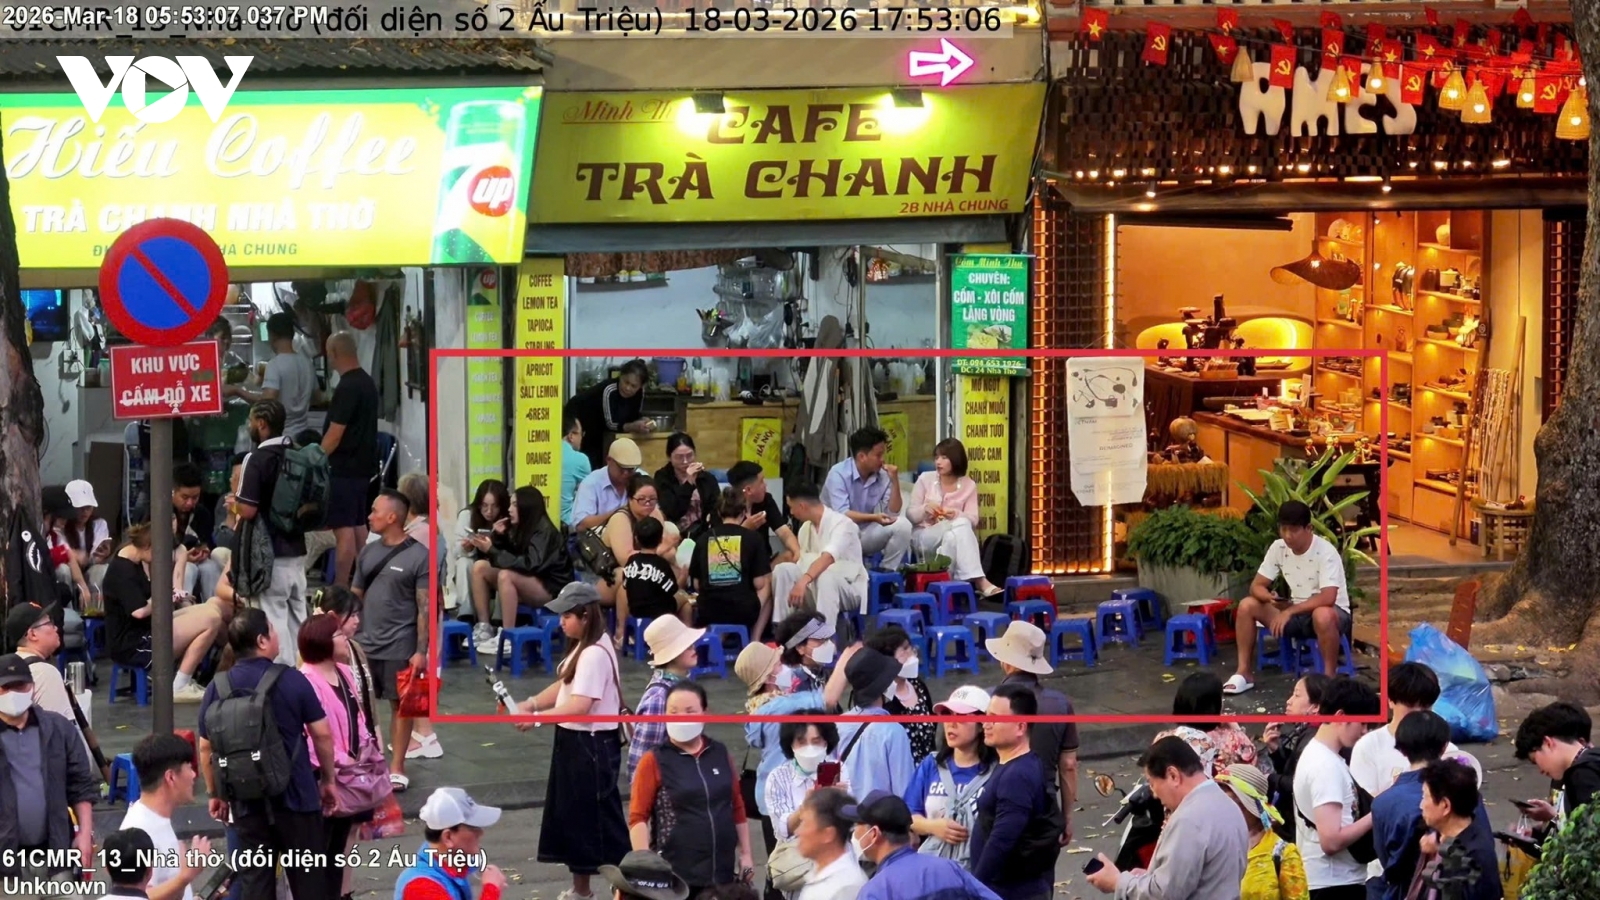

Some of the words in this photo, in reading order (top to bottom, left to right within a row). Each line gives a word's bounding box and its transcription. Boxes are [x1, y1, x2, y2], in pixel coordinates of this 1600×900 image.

[563, 100, 633, 120] Minh
[707, 103, 884, 145] CAFE
[205, 112, 418, 189] Coffee
[576, 152, 715, 204] TRÀ
[744, 154, 998, 200] CHANH
[899, 202, 919, 214] 2B
[923, 199, 954, 213] NHÀ
[958, 198, 1009, 212] CHUNG
[21, 197, 87, 233] TRÀ
[243, 243, 298, 256] CHUNG
[529, 274, 553, 287] COFFEE
[968, 271, 1010, 285] CHUYÊN:
[954, 286, 975, 304] CỐM
[984, 289, 1000, 304] XÔI
[1003, 287, 1024, 305] CỐM
[523, 297, 545, 310] LEMON
[546, 296, 558, 309] TEA
[963, 305, 987, 321] LÀNG
[990, 306, 1015, 322] VÒNG
[527, 319, 553, 332] TAPIOCA
[131, 356, 163, 375] KHU
[168, 353, 200, 375] VỰC
[526, 363, 553, 376] APRICOT
[122, 383, 160, 407] CẤM
[190, 385, 211, 402] XE
[520, 385, 535, 399] SALT
[536, 385, 558, 398] LEMON
[965, 401, 987, 415] CHANH
[528, 430, 550, 443] LEMON
[966, 424, 988, 438] CHANH
[526, 452, 551, 465] ORANGE
[987, 447, 1002, 460] CAM
[984, 470, 1001, 483] CHUA
